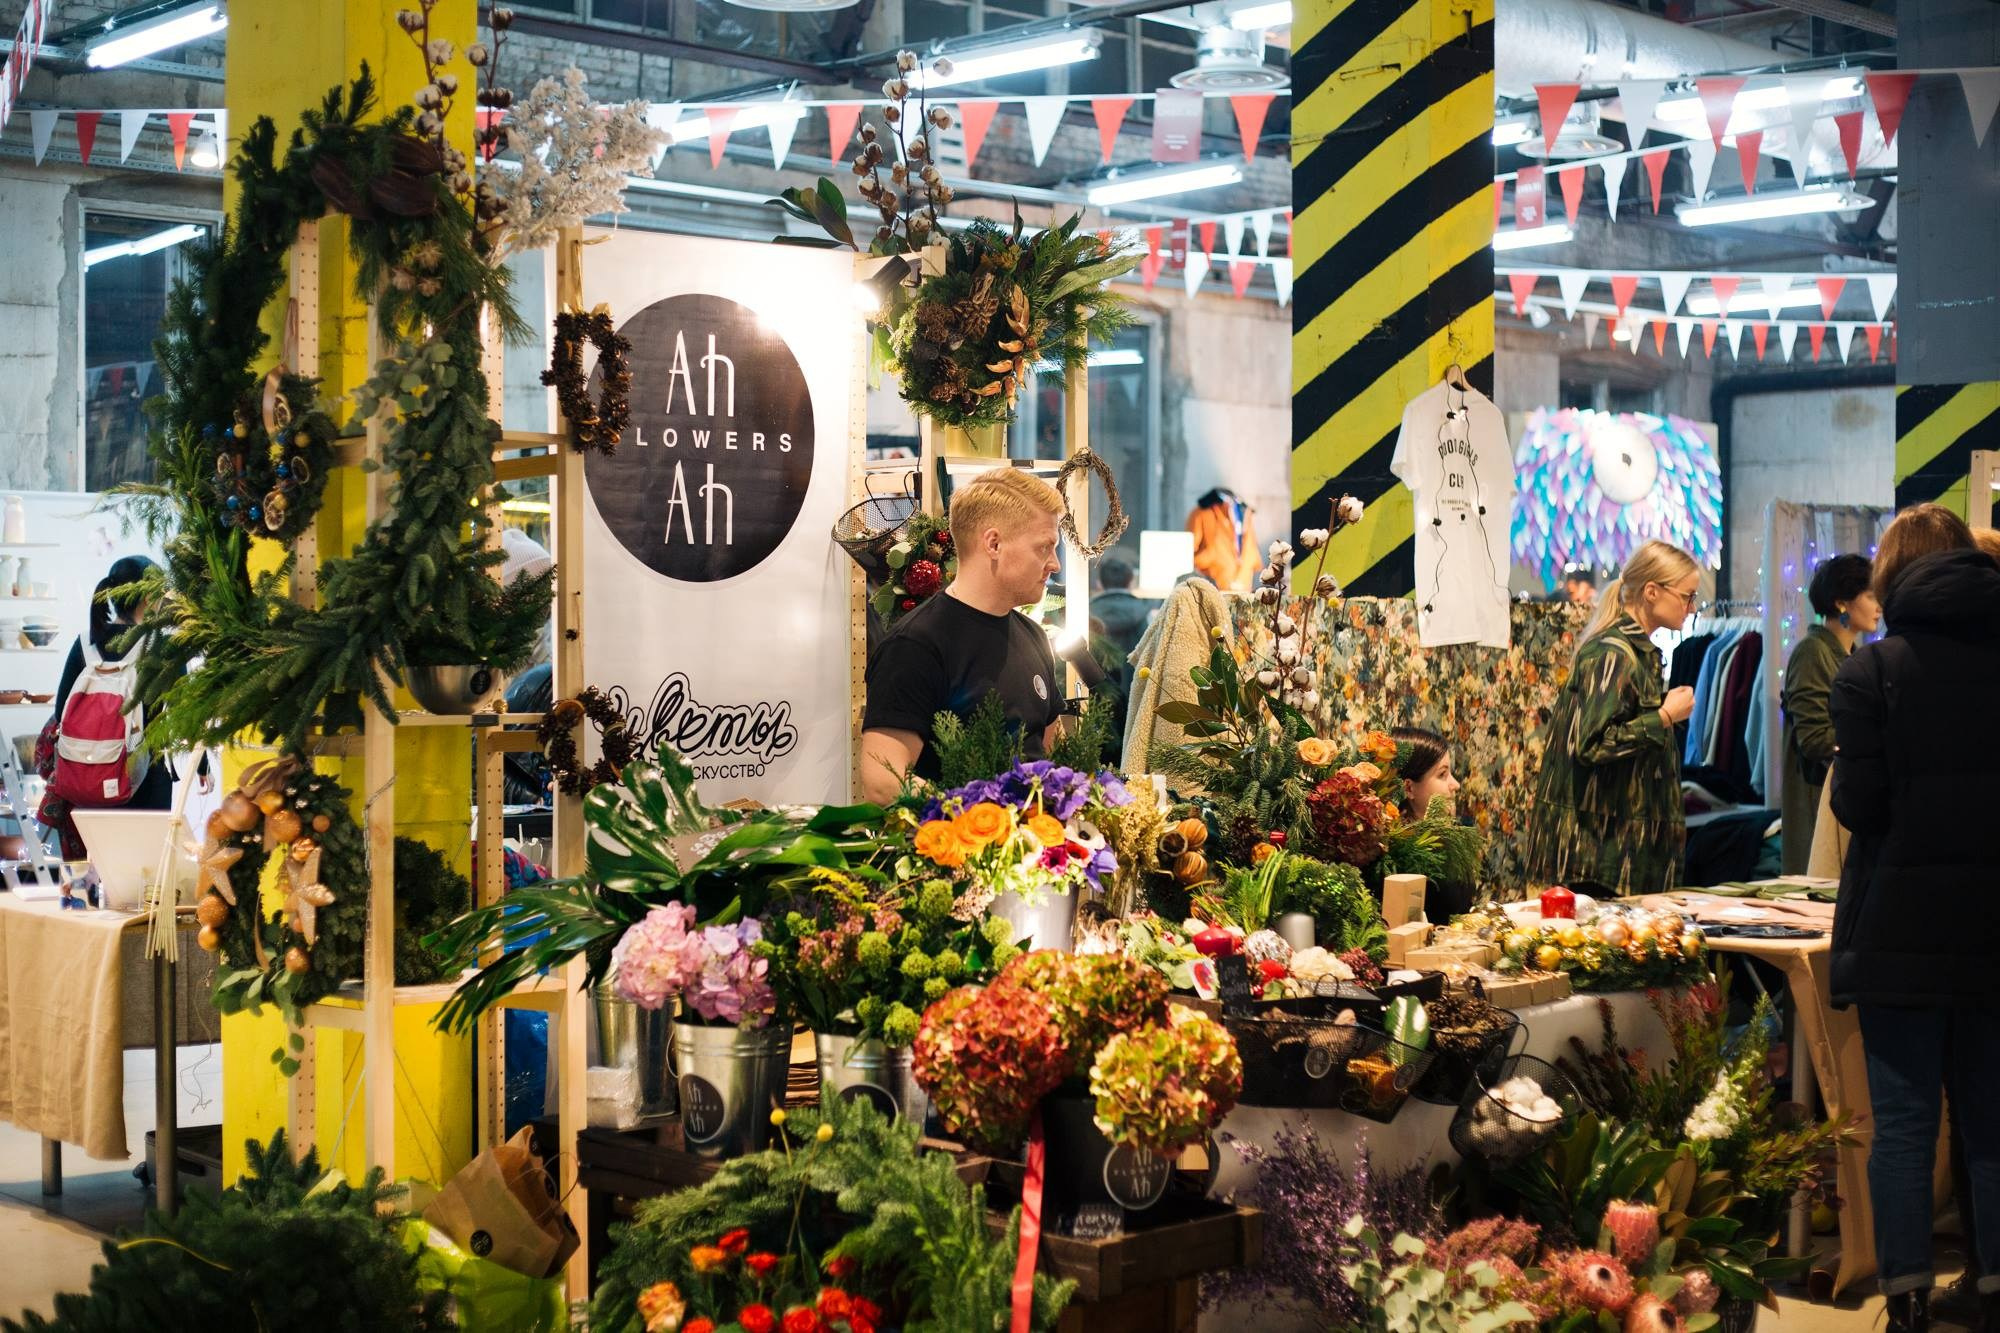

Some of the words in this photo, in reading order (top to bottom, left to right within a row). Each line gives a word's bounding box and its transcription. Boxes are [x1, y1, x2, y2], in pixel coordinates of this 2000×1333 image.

[665, 329, 735, 417] Ah
[635, 427, 793, 453] LOWERS
[664, 459, 733, 545] Ah
[692, 763, 766, 780] СКУССТВО
[1129, 1175, 1152, 1199] Ah
